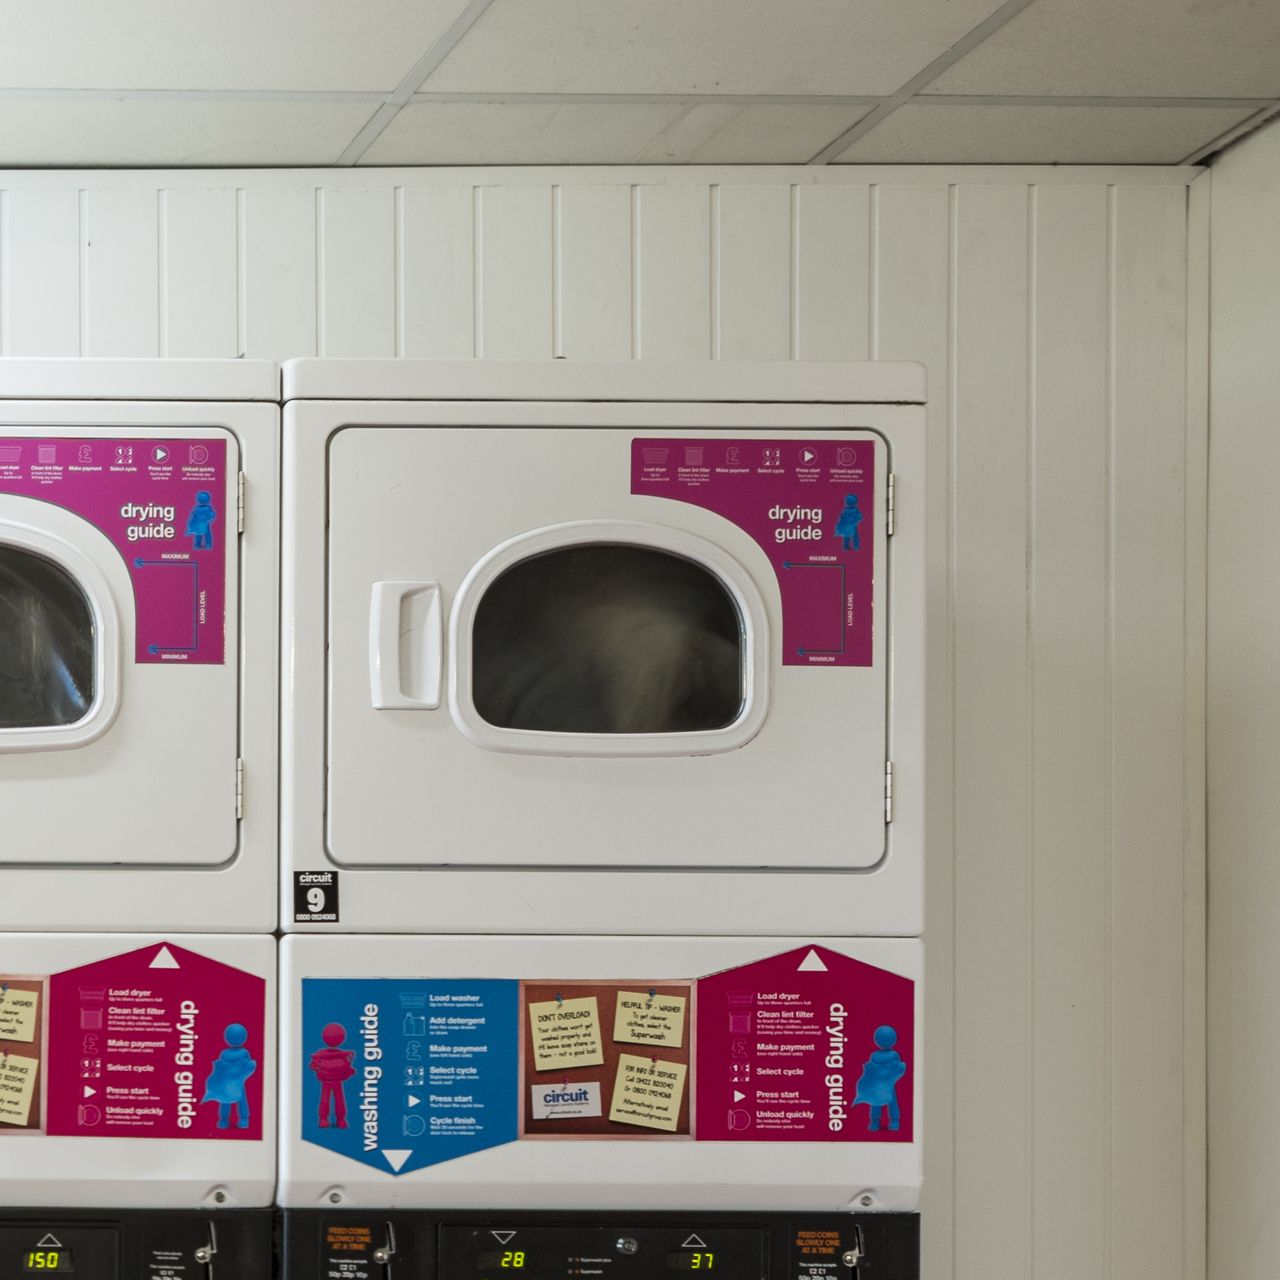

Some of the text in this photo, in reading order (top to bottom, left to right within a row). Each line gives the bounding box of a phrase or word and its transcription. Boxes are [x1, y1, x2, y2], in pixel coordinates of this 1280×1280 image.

[121, 504, 175, 521] drying
[768, 505, 822, 522] drying
[127, 524, 175, 541] guide
[775, 526, 822, 542] guide
[300, 872, 333, 882] circuit
[307, 888, 325, 912] 9
[175, 1000, 193, 1129] drying guide
[826, 1002, 844, 1133] drying guide
[363, 1003, 381, 1152] washing guide
[543, 1089, 589, 1105] circuit
[28, 1252, 58, 1268] 150
[501, 1252, 525, 1268] 28
[691, 1254, 714, 1269] 37
